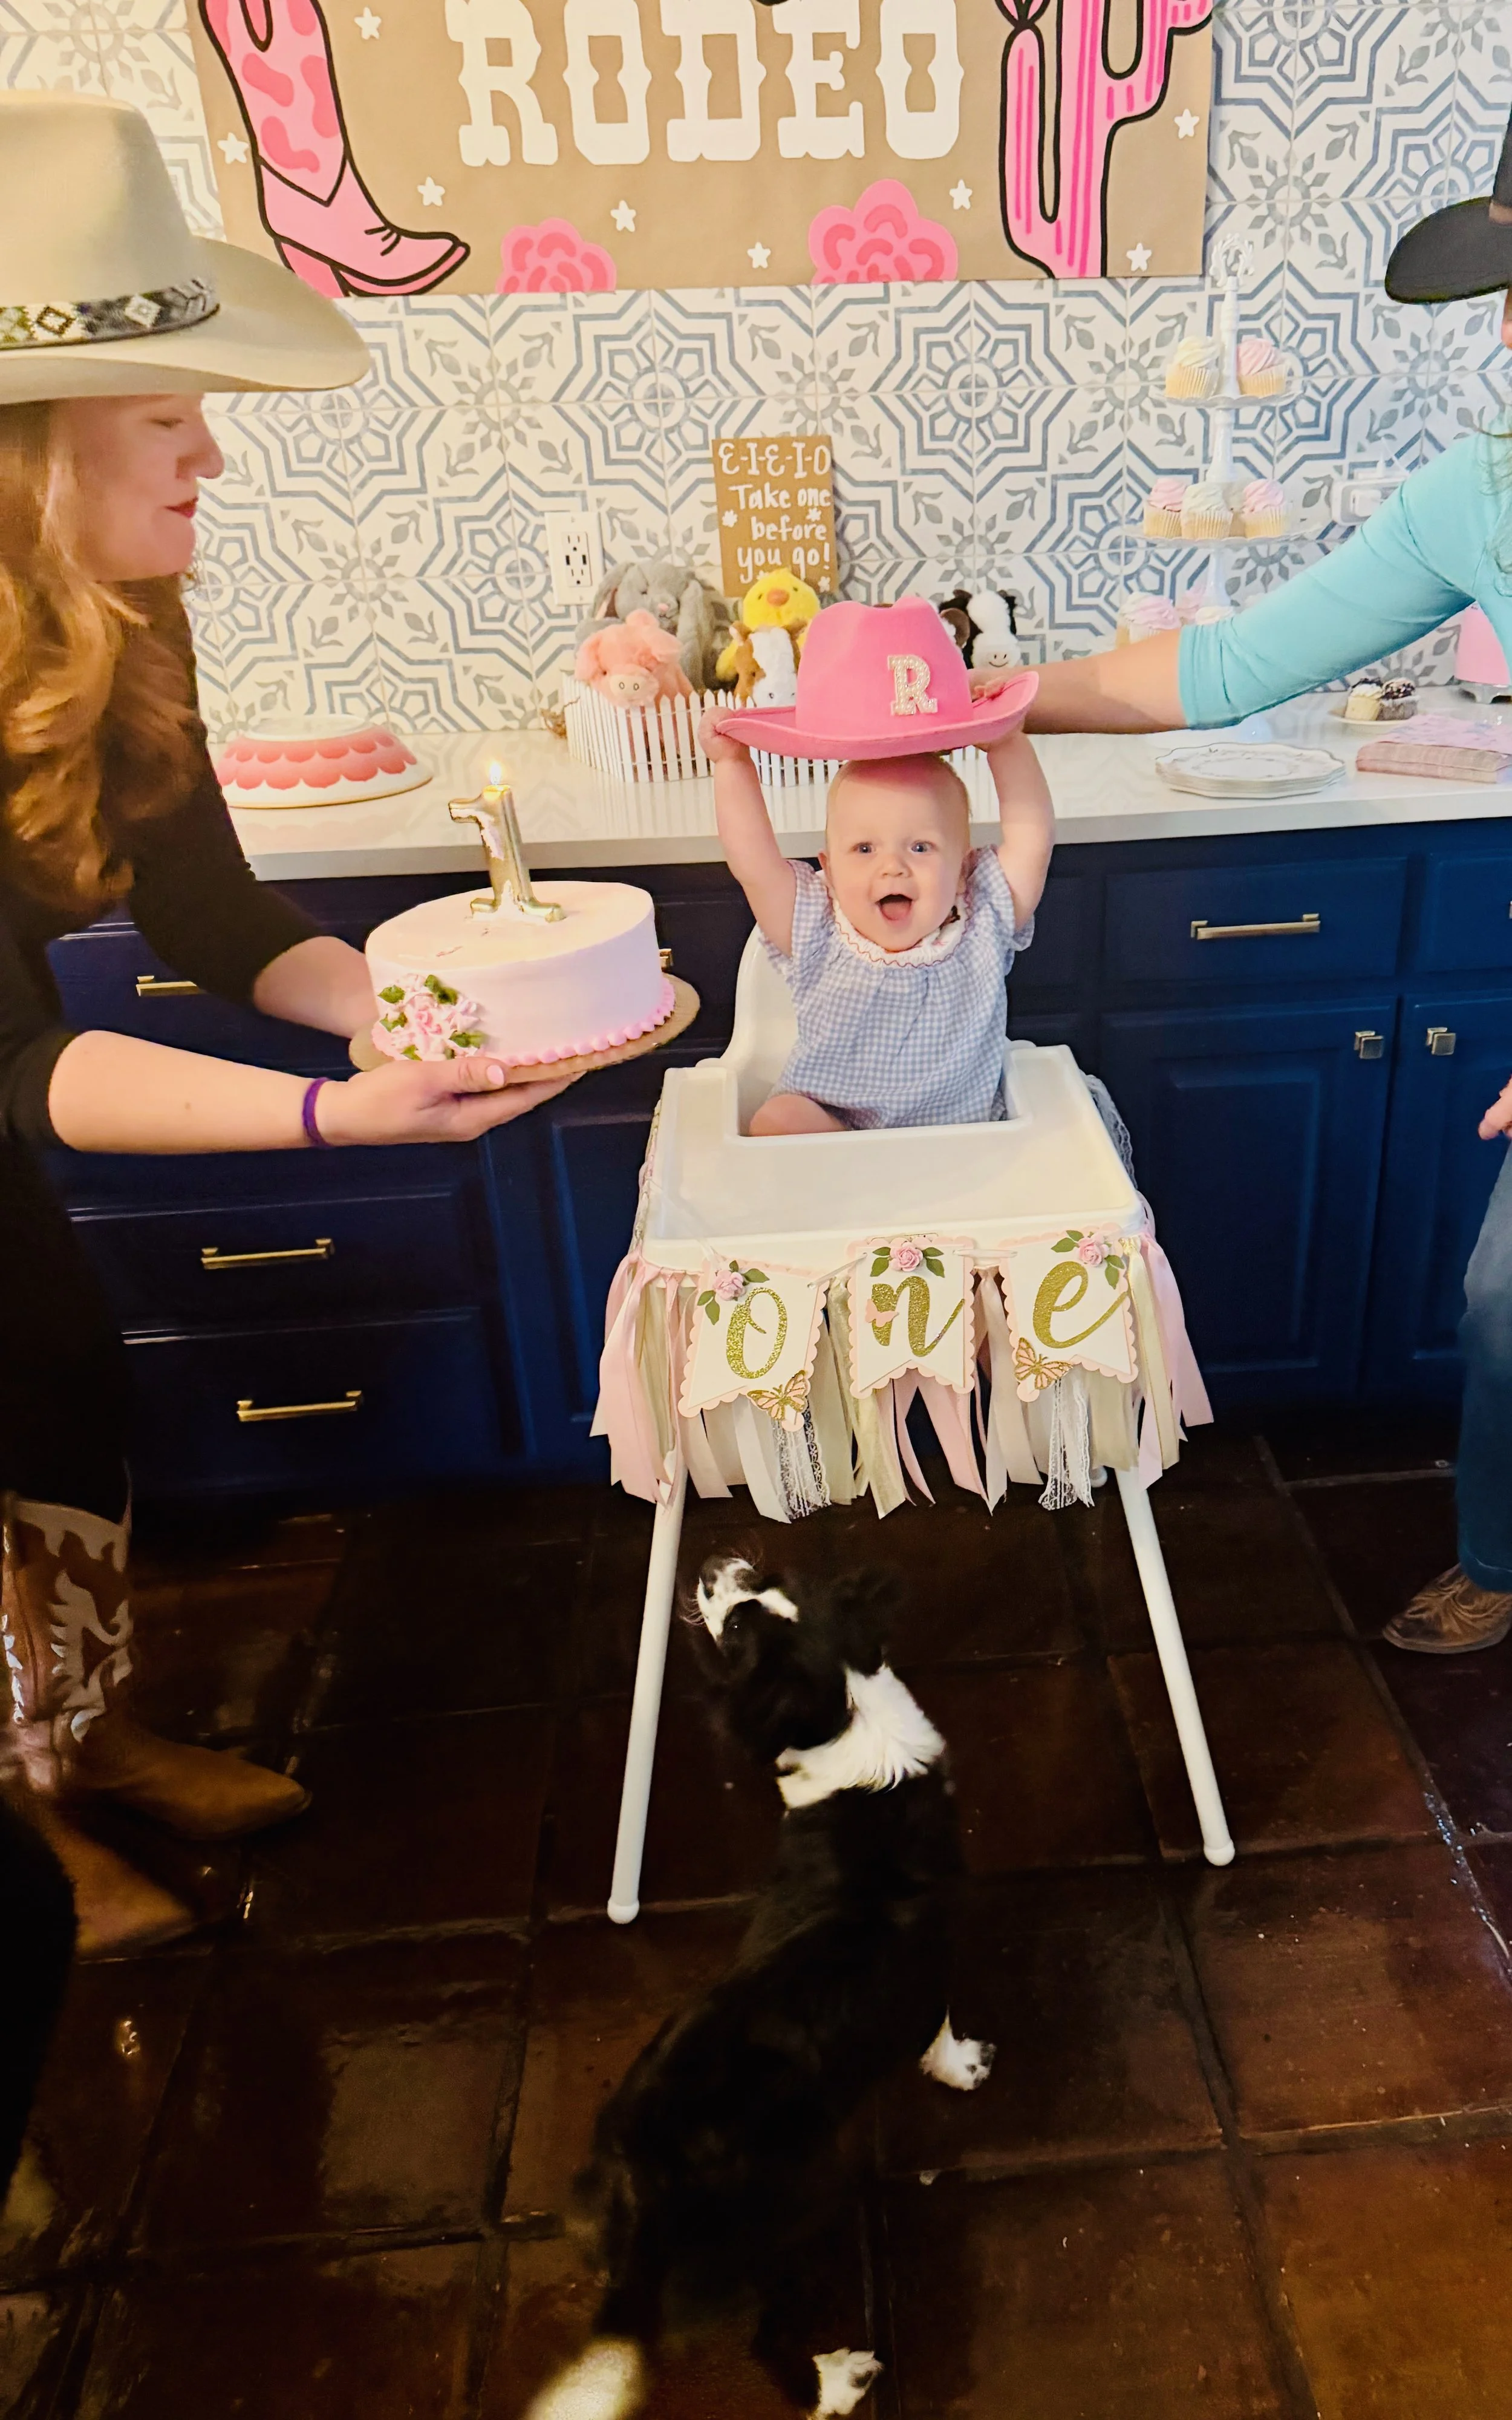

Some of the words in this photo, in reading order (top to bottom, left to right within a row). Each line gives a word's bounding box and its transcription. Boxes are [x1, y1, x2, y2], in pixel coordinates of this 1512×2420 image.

[446, 0, 964, 166] RODEO
[728, 482, 792, 510] Take
[797, 488, 831, 507] one
[751, 515, 827, 541] before
[737, 546, 782, 584] you
[792, 542, 830, 581] go!
[887, 653, 938, 716] R
[726, 1261, 1129, 1379] one
